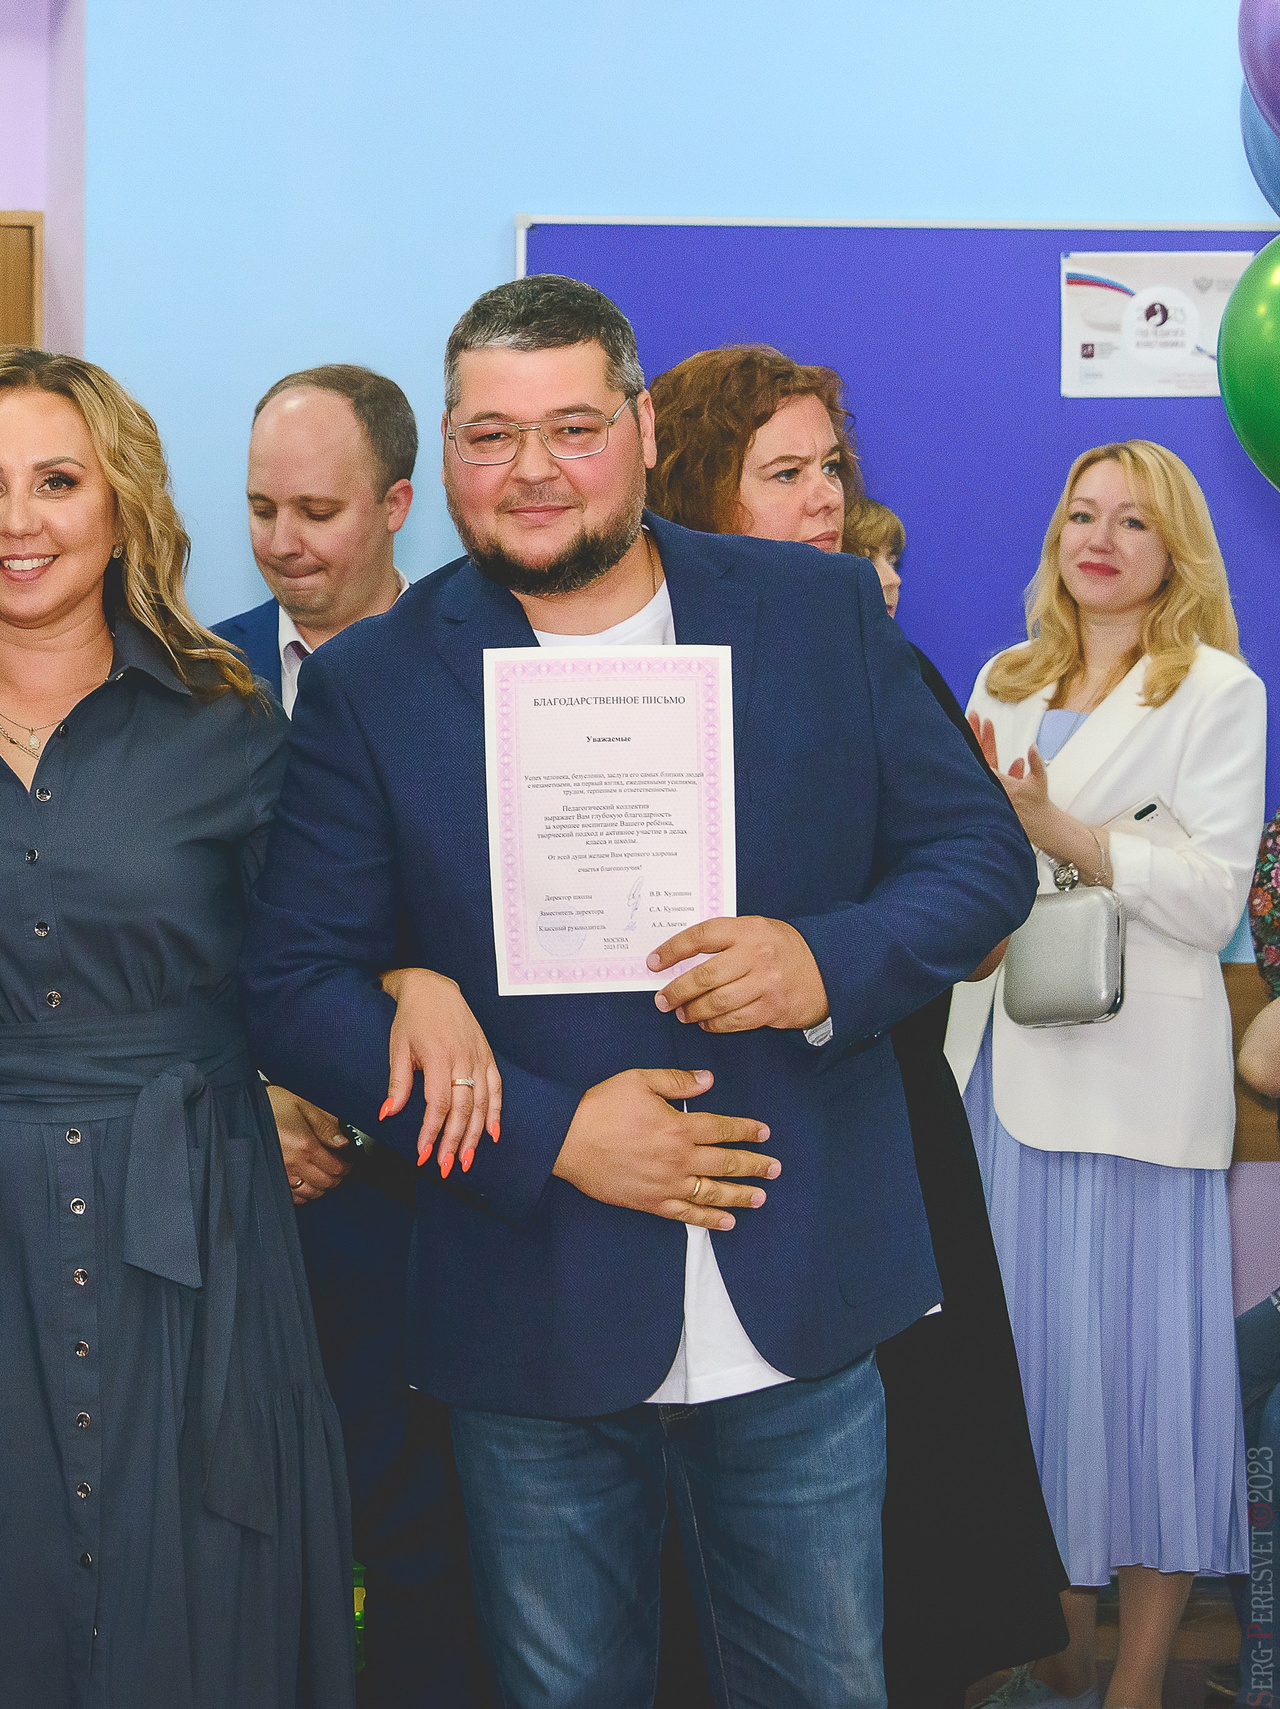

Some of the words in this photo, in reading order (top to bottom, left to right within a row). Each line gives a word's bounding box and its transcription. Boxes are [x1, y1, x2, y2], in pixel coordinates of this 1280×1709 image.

[533, 696, 640, 707] БЛАГОДАРСТВЕННОЕ
[642, 696, 685, 705] ПИСЬМО
[562, 804, 614, 812] Педагогический
[544, 814, 575, 822] выражает
[591, 812, 623, 821] глубокую
[624, 811, 672, 820] благодарность
[635, 829, 662, 837] участие
